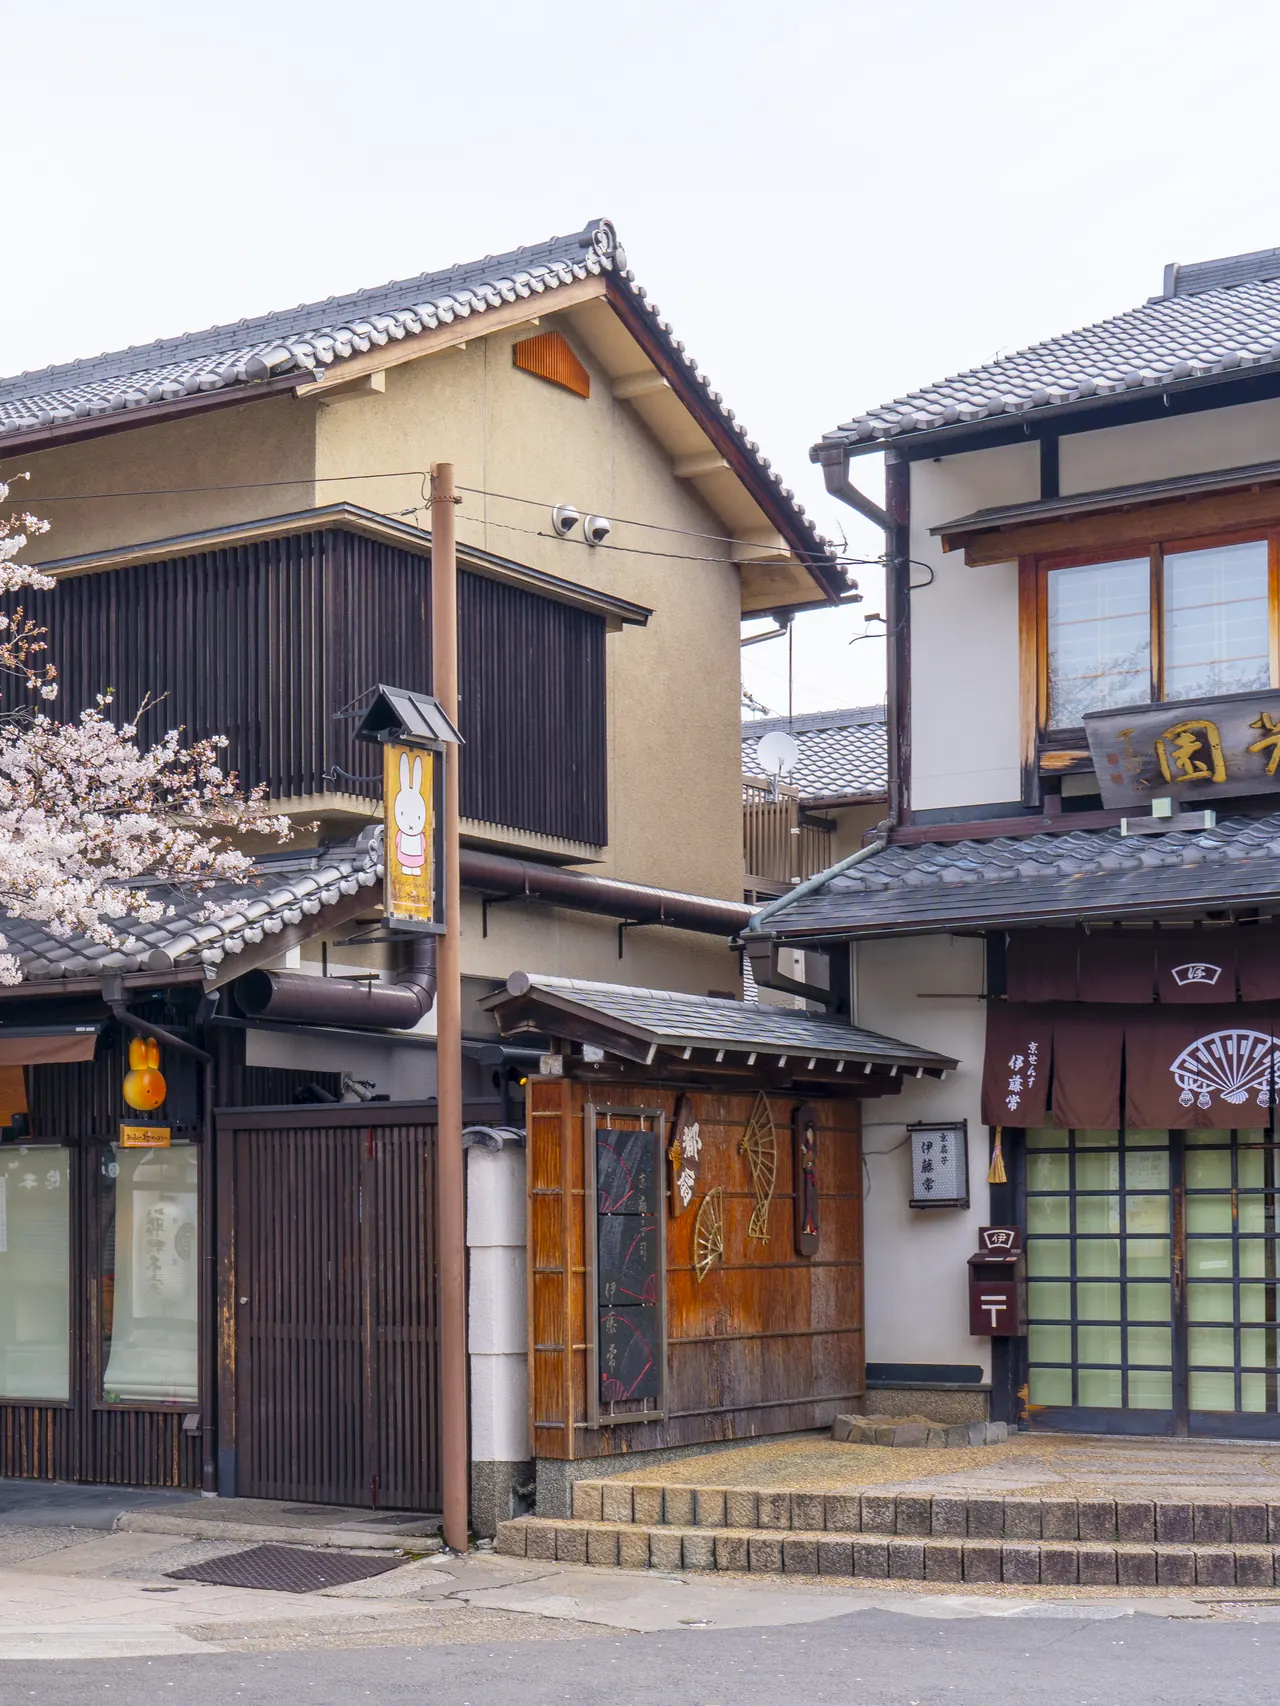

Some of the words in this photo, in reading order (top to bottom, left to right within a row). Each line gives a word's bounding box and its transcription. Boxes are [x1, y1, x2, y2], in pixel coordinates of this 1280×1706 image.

[1005, 1054, 1024, 1112] 伊藤常
[1027, 1041, 1039, 1089] 京せんす
[921, 1140, 935, 1193] 伊藤常
[939, 1132, 949, 1166] 京扇子
[991, 1232, 1008, 1244] 伊
